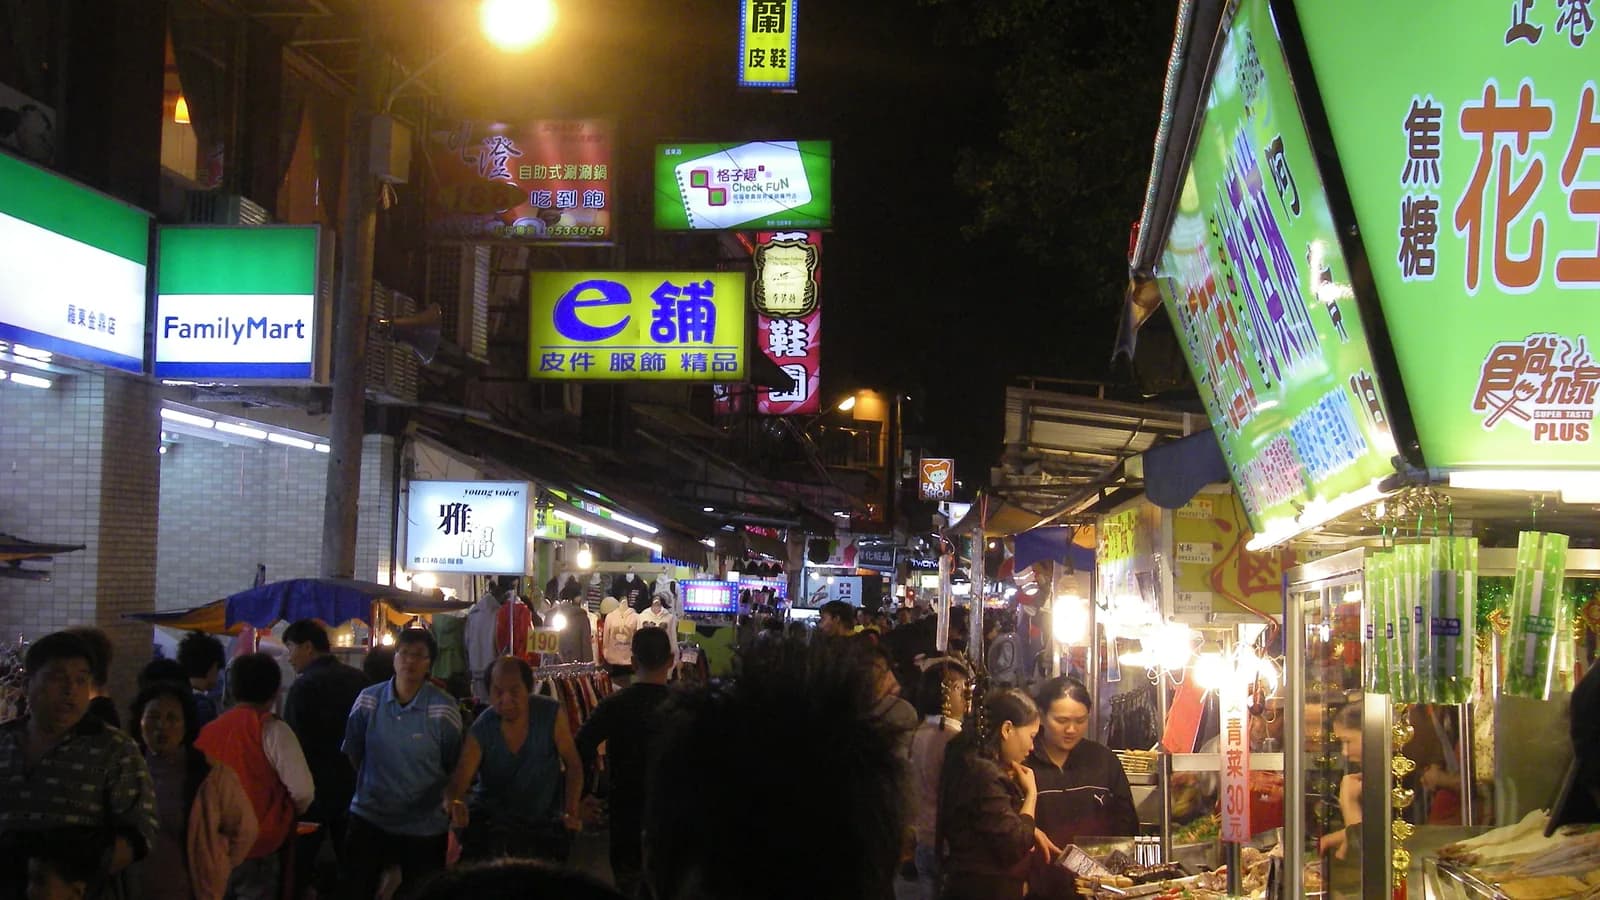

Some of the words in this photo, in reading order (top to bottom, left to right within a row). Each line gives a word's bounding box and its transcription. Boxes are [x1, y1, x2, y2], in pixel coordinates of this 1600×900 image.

[749, 48, 787, 68] 皮鞋
[519, 164, 608, 180] 自助式涮涮鍋
[717, 168, 757, 182] 格子趣
[766, 177, 789, 191] FUN
[1400, 98, 1442, 278] 焦糖
[532, 190, 604, 208] 吃到飽
[164, 316, 305, 345] FamilyMart
[539, 352, 595, 373] 皮件
[610, 352, 667, 373] 服飾
[681, 352, 738, 373] 精品
[1566, 411, 1591, 419] TASTE
[1535, 423, 1589, 441] PLUS
[495, 489, 519, 497] voice
[922, 482, 945, 492] EASY
[529, 631, 557, 651] 190
